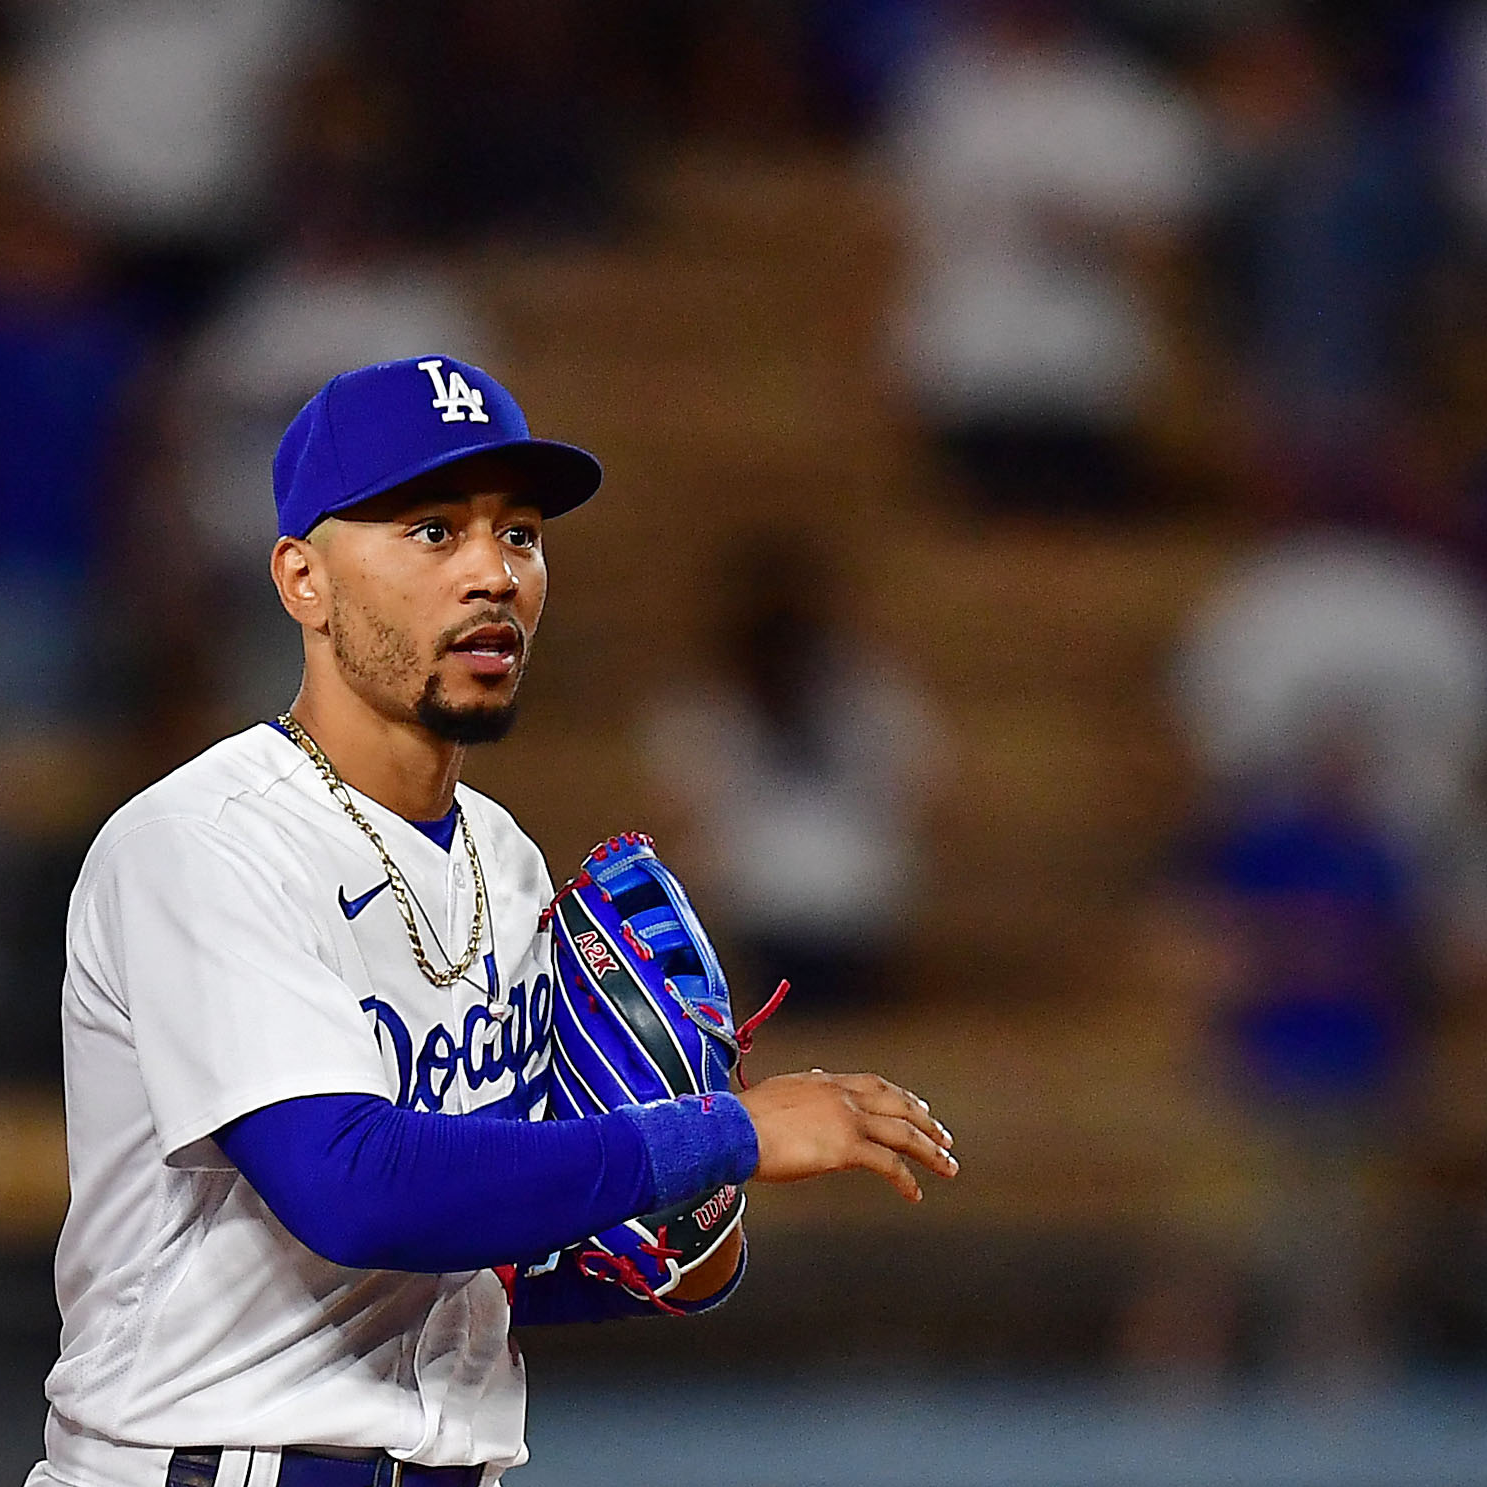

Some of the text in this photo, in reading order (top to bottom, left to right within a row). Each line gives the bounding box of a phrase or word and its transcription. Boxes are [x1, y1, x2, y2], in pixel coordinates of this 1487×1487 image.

[418, 360, 489, 423] LA
[574, 930, 621, 980] A2K
[359, 952, 553, 1118] Dodge
